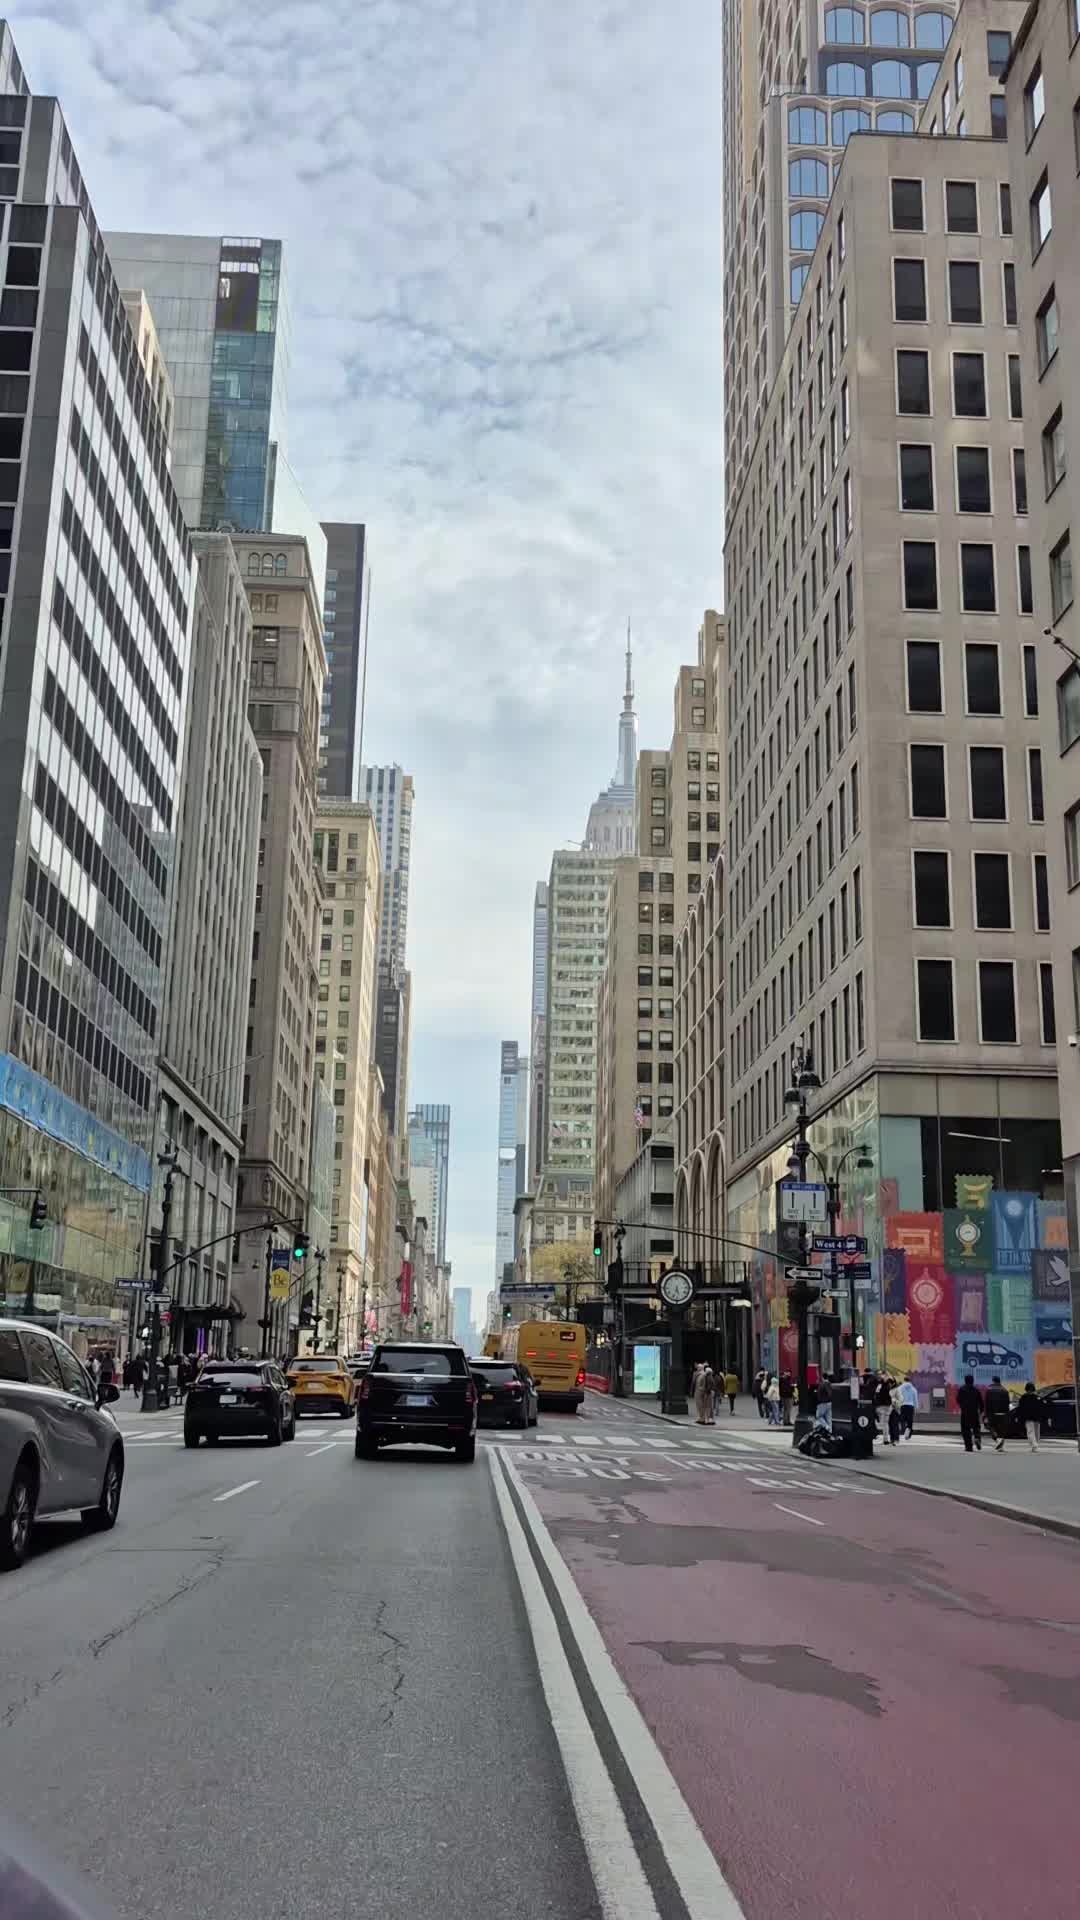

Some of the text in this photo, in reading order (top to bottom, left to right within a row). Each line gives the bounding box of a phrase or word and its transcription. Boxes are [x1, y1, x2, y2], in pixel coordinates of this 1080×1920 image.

[816, 1240, 835, 1249] West
[516, 1452, 632, 1466] ONLY
[546, 1466, 673, 1481] BUS
[744, 1477, 888, 1495] BUS
